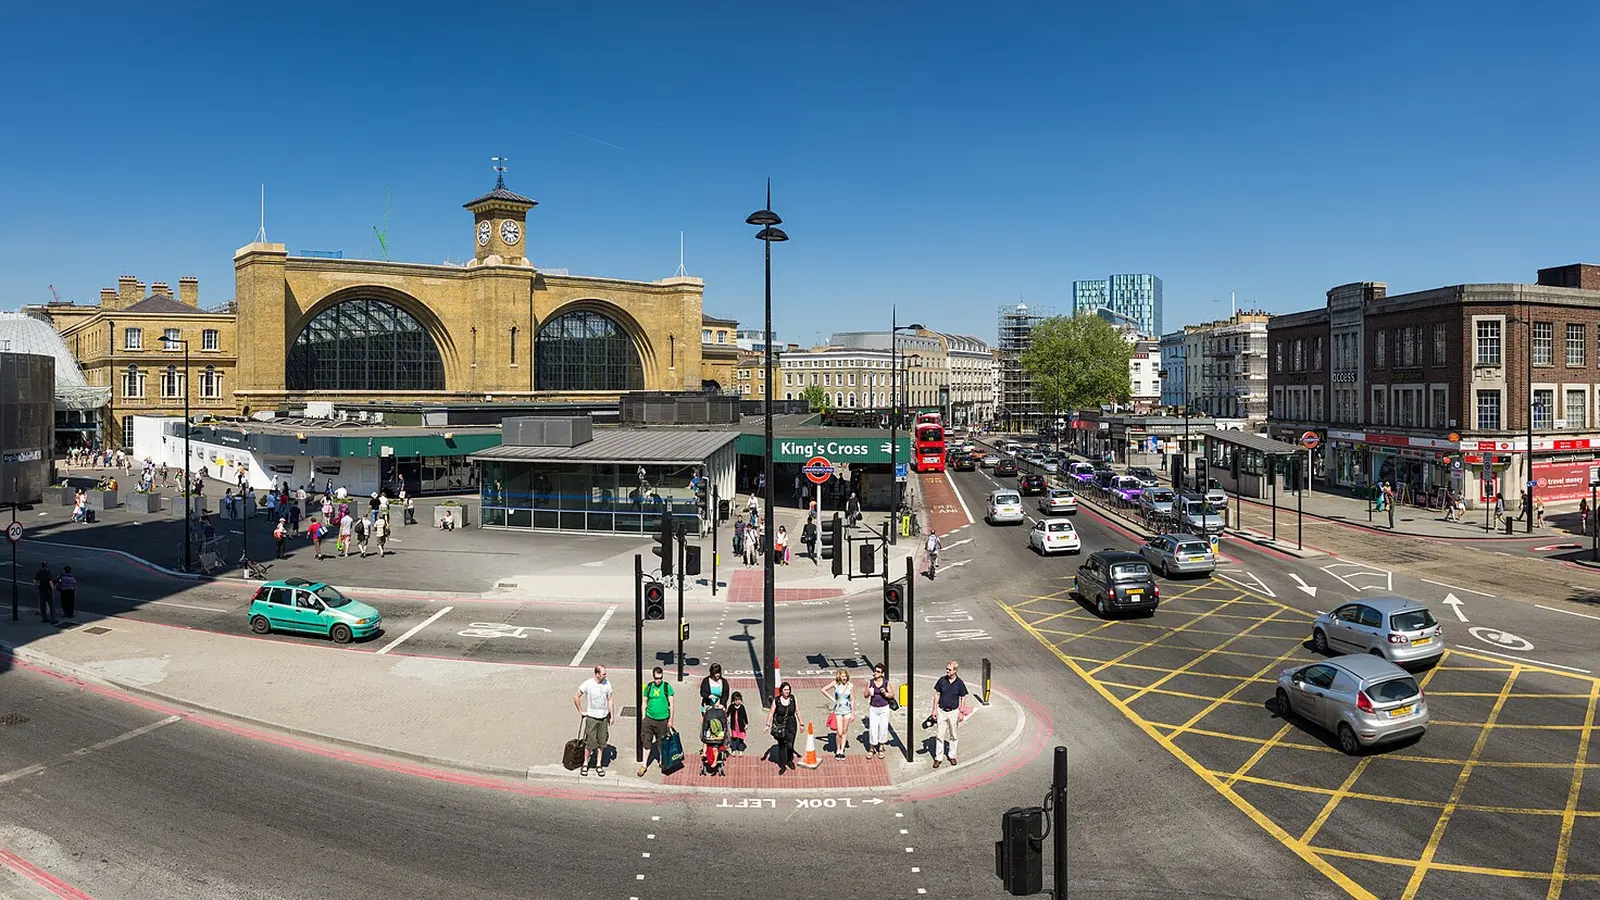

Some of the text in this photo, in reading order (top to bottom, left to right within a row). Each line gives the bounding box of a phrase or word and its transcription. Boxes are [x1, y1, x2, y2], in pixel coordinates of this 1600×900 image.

[781, 442, 868, 457] King's Cross
[10, 526, 21, 536] 20
[716, 797, 858, 808] LOOK LEFT
